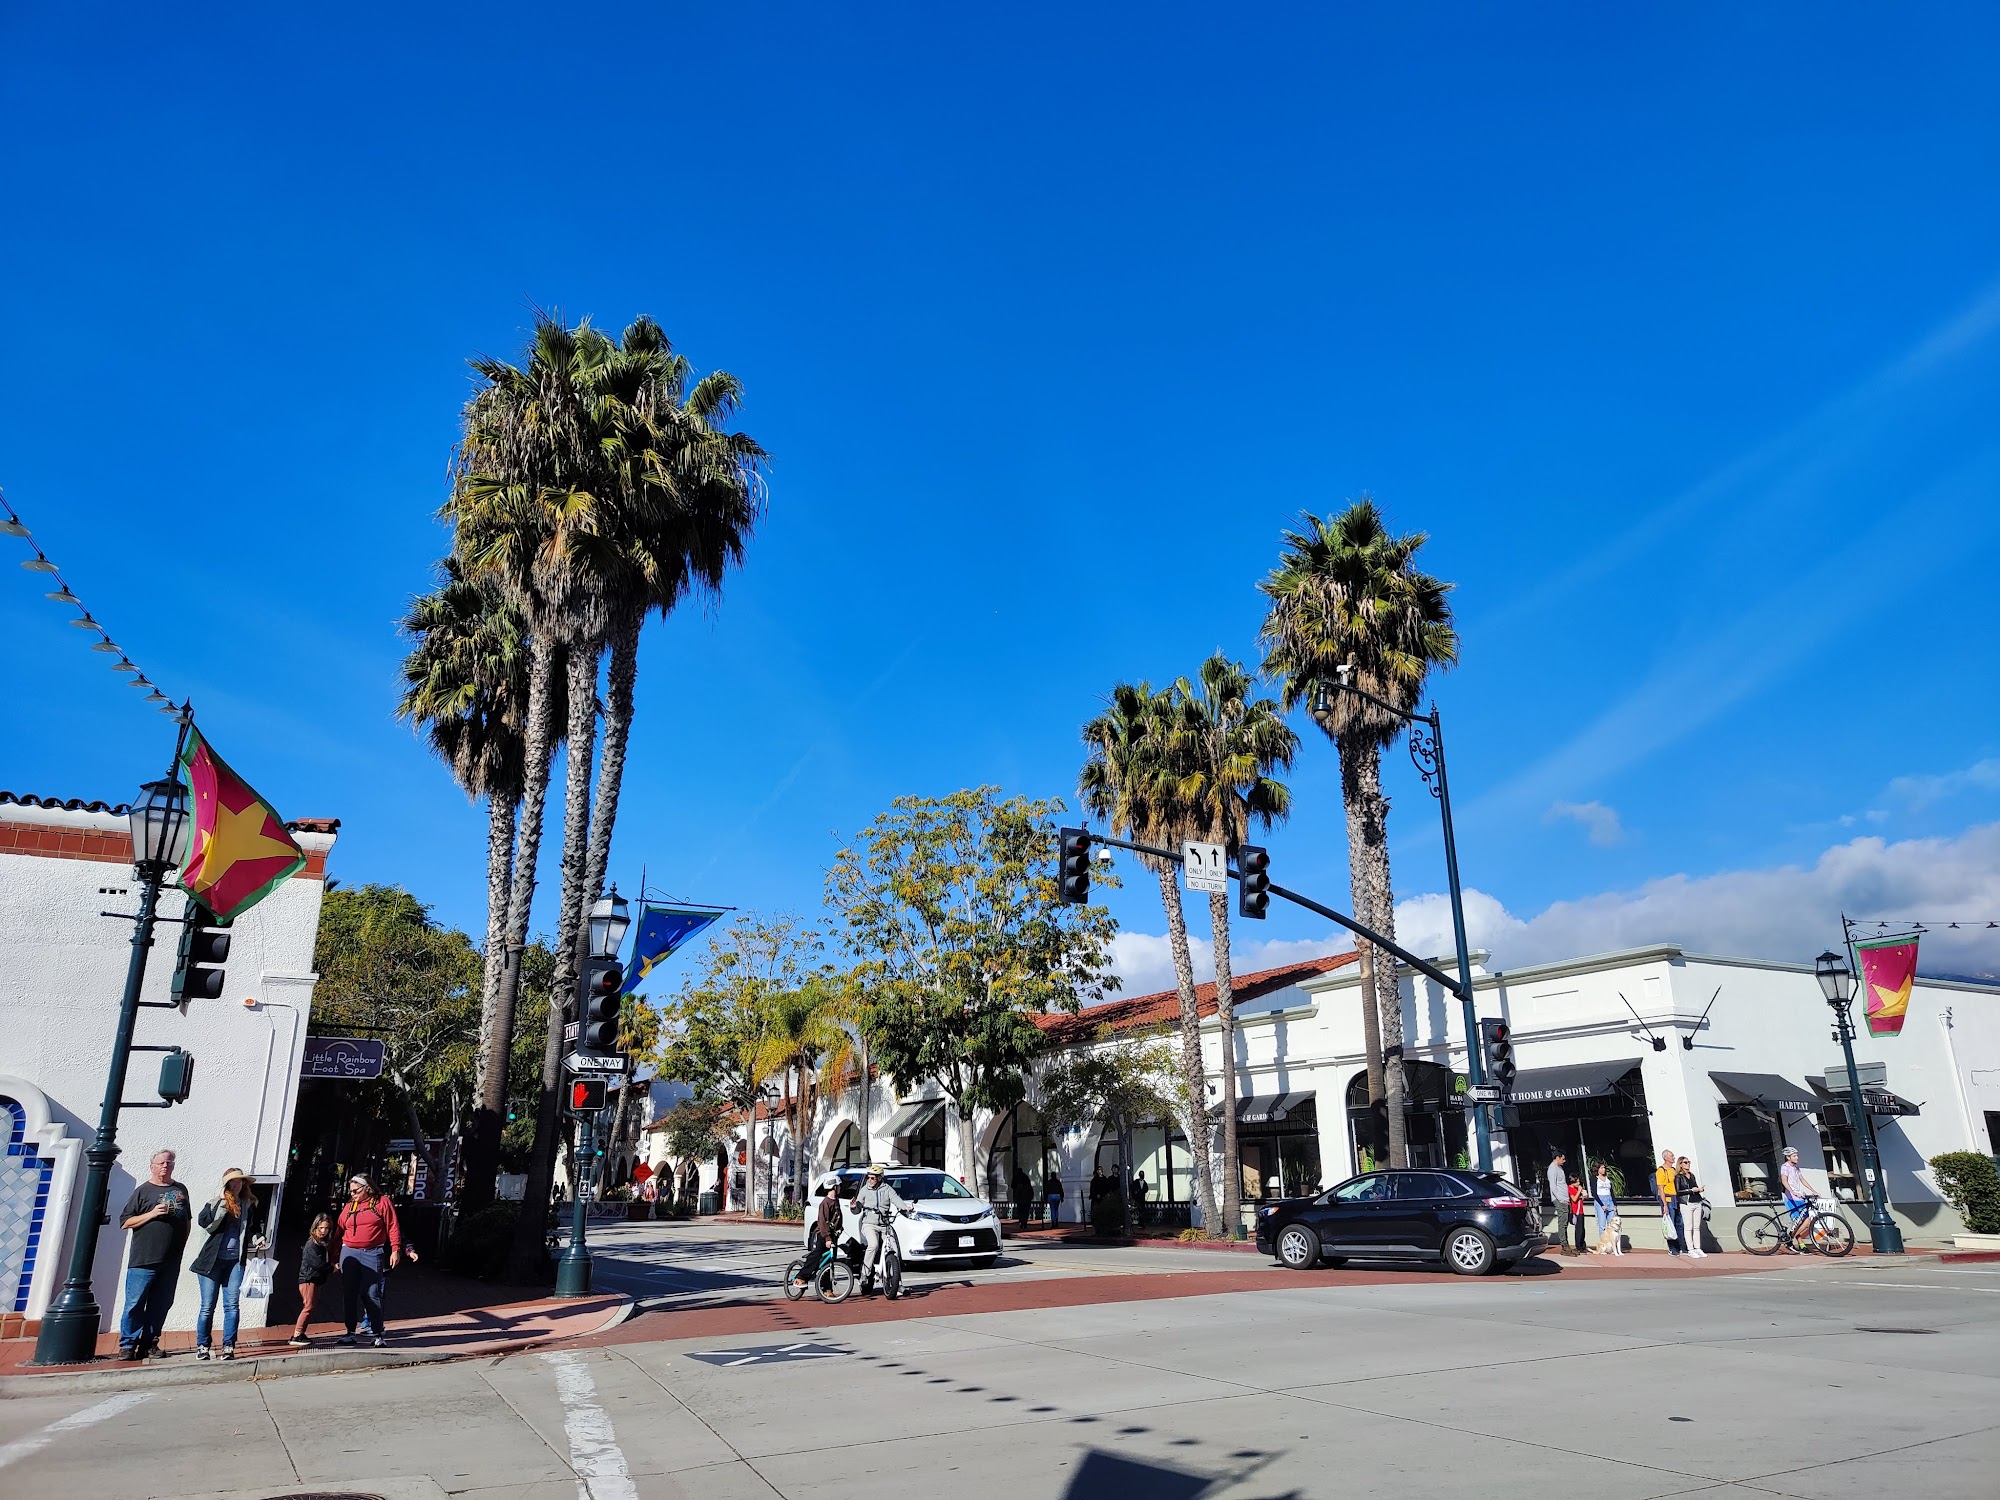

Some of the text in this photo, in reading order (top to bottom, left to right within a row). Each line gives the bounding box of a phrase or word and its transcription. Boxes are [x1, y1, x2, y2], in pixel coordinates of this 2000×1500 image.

[1189, 867, 1223, 878] ONLY ONLY
[1191, 880, 1199, 888] NO
[1208, 882, 1223, 890] TURN
[303, 1050, 377, 1064] Little Rainbow
[580, 1057, 621, 1068] ONE WAY
[312, 1062, 366, 1075] Foot Spa
[1518, 1091, 1543, 1100] HOME
[1545, 1090, 1552, 1098] &
[1554, 1086, 1591, 1098] GARDEN
[1778, 1100, 1809, 1111] HABITAT
[1251, 1113, 1274, 1121] GARDEN
